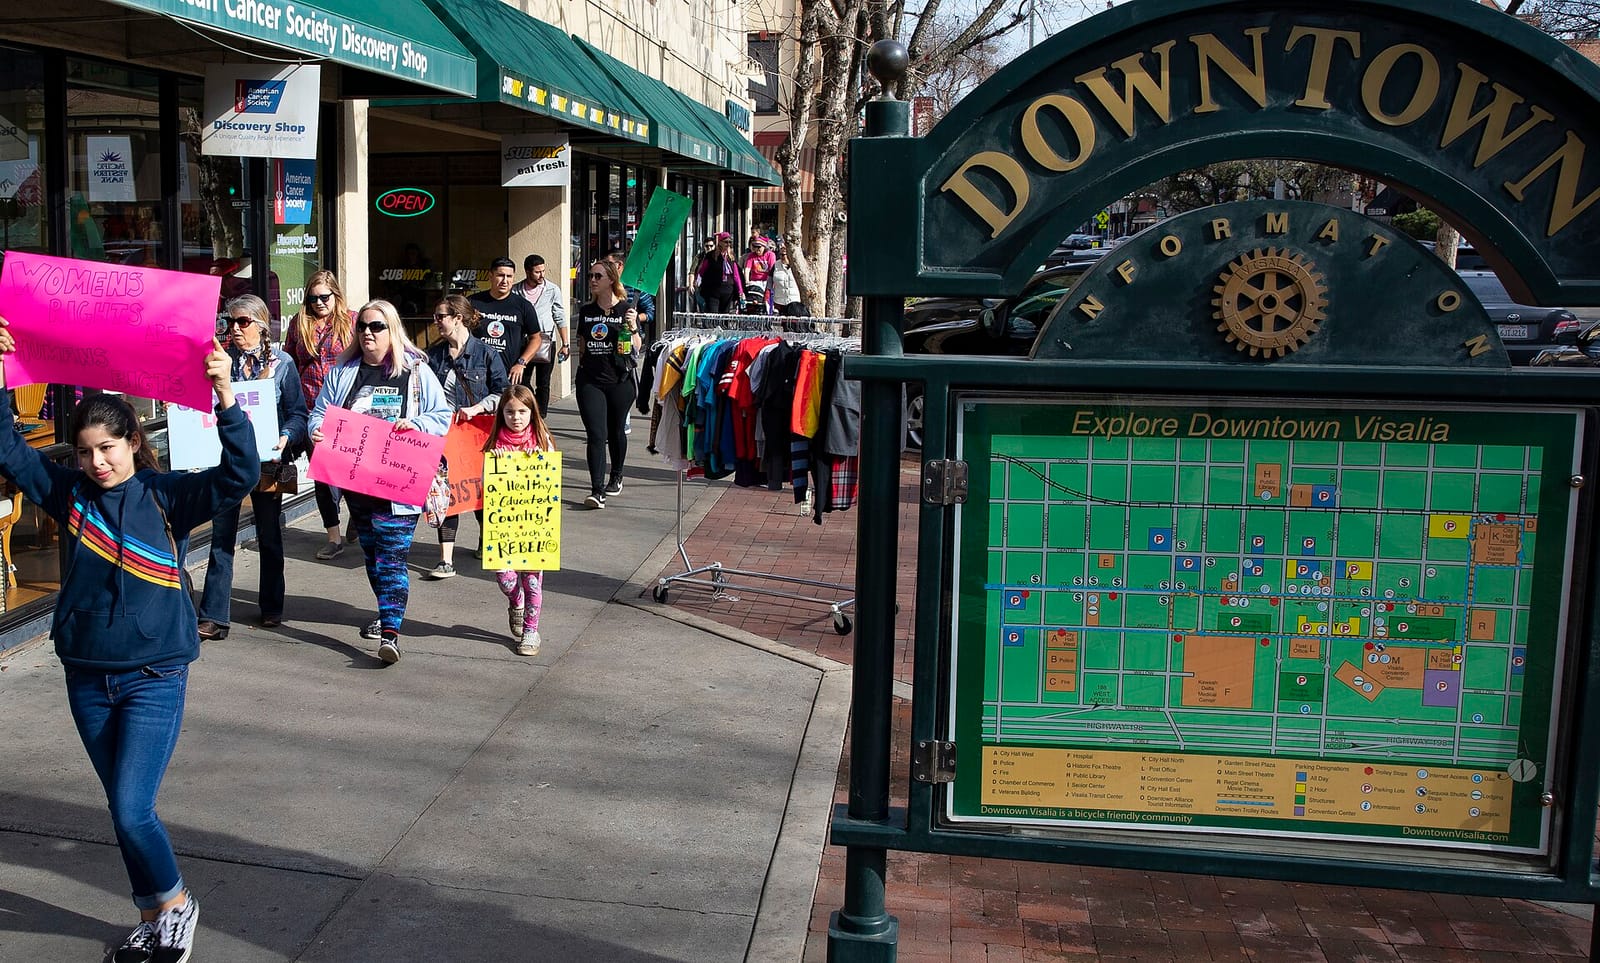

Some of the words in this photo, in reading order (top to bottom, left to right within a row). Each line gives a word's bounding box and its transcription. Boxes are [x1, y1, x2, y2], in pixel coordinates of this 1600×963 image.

[224, 0, 282, 30] Cancer
[286, 6, 338, 53] Society
[342, 23, 400, 70] Discovery
[402, 42, 428, 77] Shop
[248, 87, 279, 95] American
[247, 100, 272, 108] Society
[213, 120, 271, 134] Discovery
[275, 122, 306, 135] Shop
[940, 25, 1600, 240] DOWNTOWN
[504, 145, 566, 160] SUBWAY
[517, 165, 535, 175] eat
[536, 160, 569, 172] fresh.
[285, 172, 312, 185] American
[285, 184, 305, 197] Cancer
[285, 196, 307, 211] Society
[383, 193, 427, 210] OPEN
[1241, 257, 1301, 276] VISALIA
[10, 261, 145, 298] WOMENS
[379, 269, 432, 281] SUBWAY
[452, 269, 490, 281] SUBW
[480, 336, 507, 347] CHIRLA
[587, 341, 613, 349] CHIRLA
[374, 387, 397, 395] NEVER
[1071, 410, 1180, 442] Explore
[1187, 412, 1342, 440] Downtown
[1353, 415, 1450, 442] Visalia
[489, 456, 507, 475] I
[516, 461, 551, 472] want
[1263, 470, 1271, 478] H
[487, 484, 497, 493] a
[506, 480, 552, 494] Healthy
[499, 494, 551, 507] Educated
[488, 507, 553, 526] Country!
[1527, 521, 1534, 529] D
[488, 530, 510, 541] I'm
[514, 529, 540, 539] such
[1480, 532, 1486, 540] J
[1492, 532, 1499, 540] K
[1225, 582, 1233, 590] G
[1432, 606, 1440, 615] Q
[1479, 622, 1486, 630] R
[1051, 634, 1058, 642] A
[1051, 655, 1057, 663] B
[1392, 656, 1400, 664] M
[1431, 655, 1438, 663] N
[1224, 688, 1230, 696] F
[1086, 722, 1126, 732] HIGHWAY
[1386, 737, 1428, 746] HIGHWAY
[1295, 763, 1315, 771] Parking
[1315, 764, 1350, 772] Designations
[1373, 786, 1393, 794] Parking
[980, 805, 1028, 815] Downtown
[1029, 807, 1057, 817] Visalia
[1059, 809, 1066, 817] is
[1075, 809, 1105, 820] bicycle
[1106, 811, 1139, 822] friendly
[1141, 813, 1193, 824] community
[1242, 807, 1260, 815] Trolley
[1308, 808, 1338, 816] Convention
[1402, 826, 1509, 842] DowntownVisalia.com
